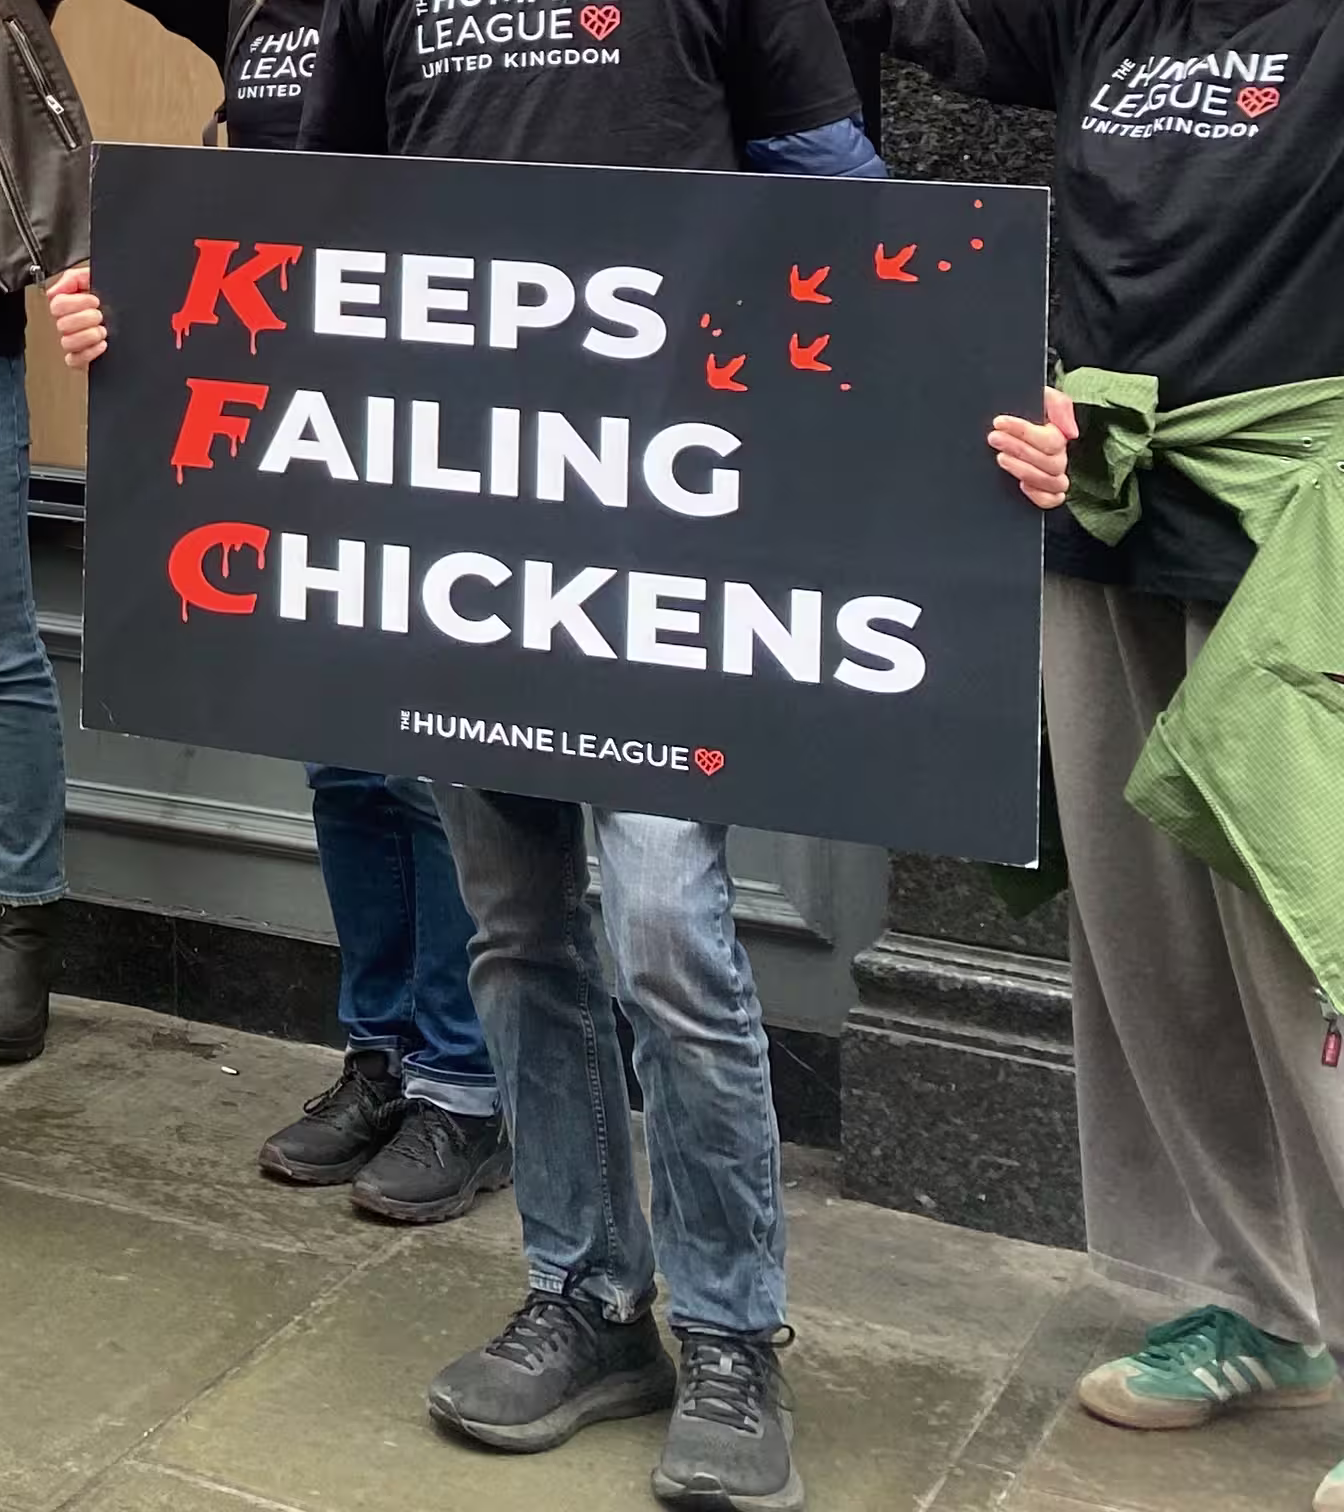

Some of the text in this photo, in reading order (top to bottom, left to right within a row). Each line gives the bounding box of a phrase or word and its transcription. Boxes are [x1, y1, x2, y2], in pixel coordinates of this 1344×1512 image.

[417, 7, 574, 54] LEAGUE
[421, 49, 619, 78] UNITED KINGDOM
[1112, 57, 1137, 81] THE
[238, 84, 301, 99] UNITED
[170, 238, 668, 357] KEEPS
[169, 377, 743, 518] FAILING
[167, 521, 928, 694] CHICKENS
[414, 712, 553, 752] HUMANE
[562, 732, 689, 770] LEAGUE
